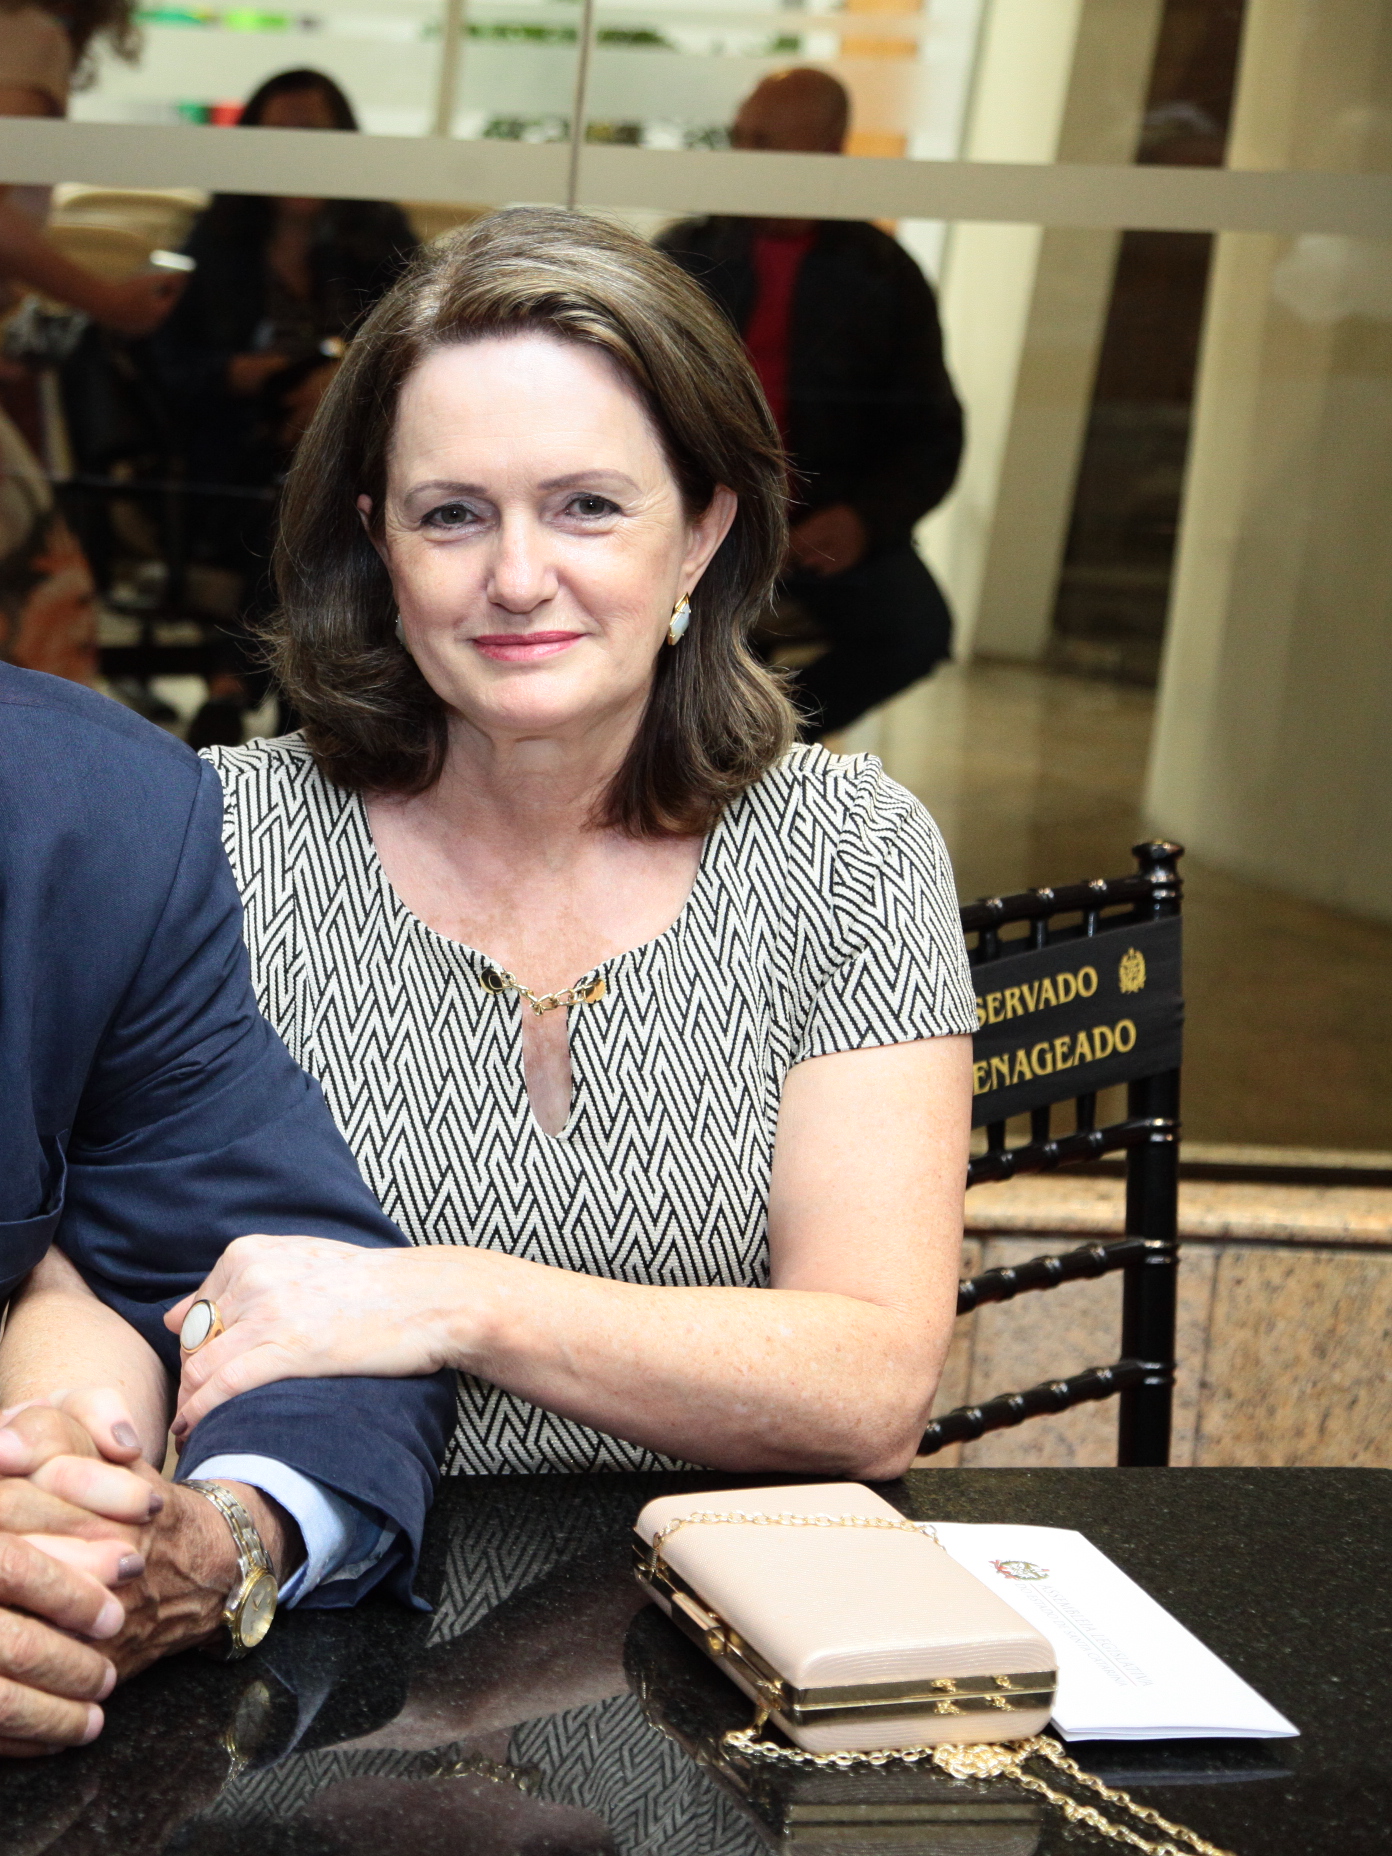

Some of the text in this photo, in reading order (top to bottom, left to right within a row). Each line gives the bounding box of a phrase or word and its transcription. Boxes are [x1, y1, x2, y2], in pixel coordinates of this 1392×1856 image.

[976, 966, 1098, 1028] SERVADO
[973, 1018, 1137, 1096] ENAGEADO
[1014, 1582, 1128, 1687] DO ESTADO DE SANTA CATARINA
[1091, 1633, 1154, 1687] LEGISLATIVA
